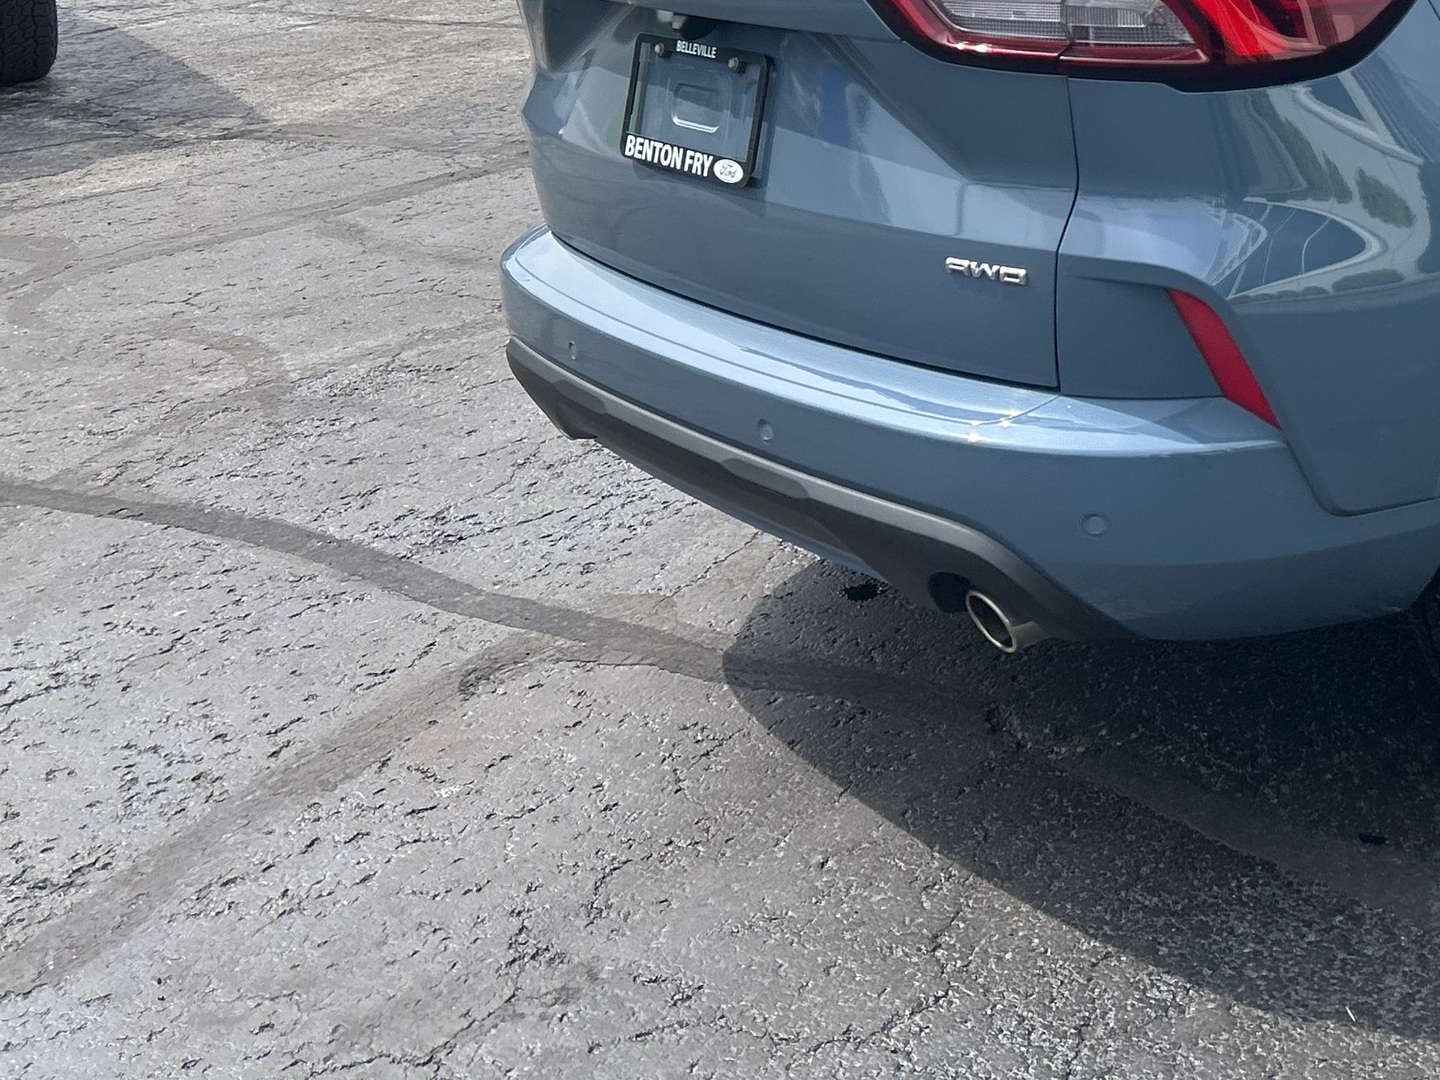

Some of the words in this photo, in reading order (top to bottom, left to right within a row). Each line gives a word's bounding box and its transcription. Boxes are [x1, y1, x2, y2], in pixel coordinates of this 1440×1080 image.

[676, 40, 718, 59] BELLEVILLE
[625, 135, 684, 170] BENTON
[684, 149, 714, 177] FRY
[945, 257, 1027, 285] AWD
